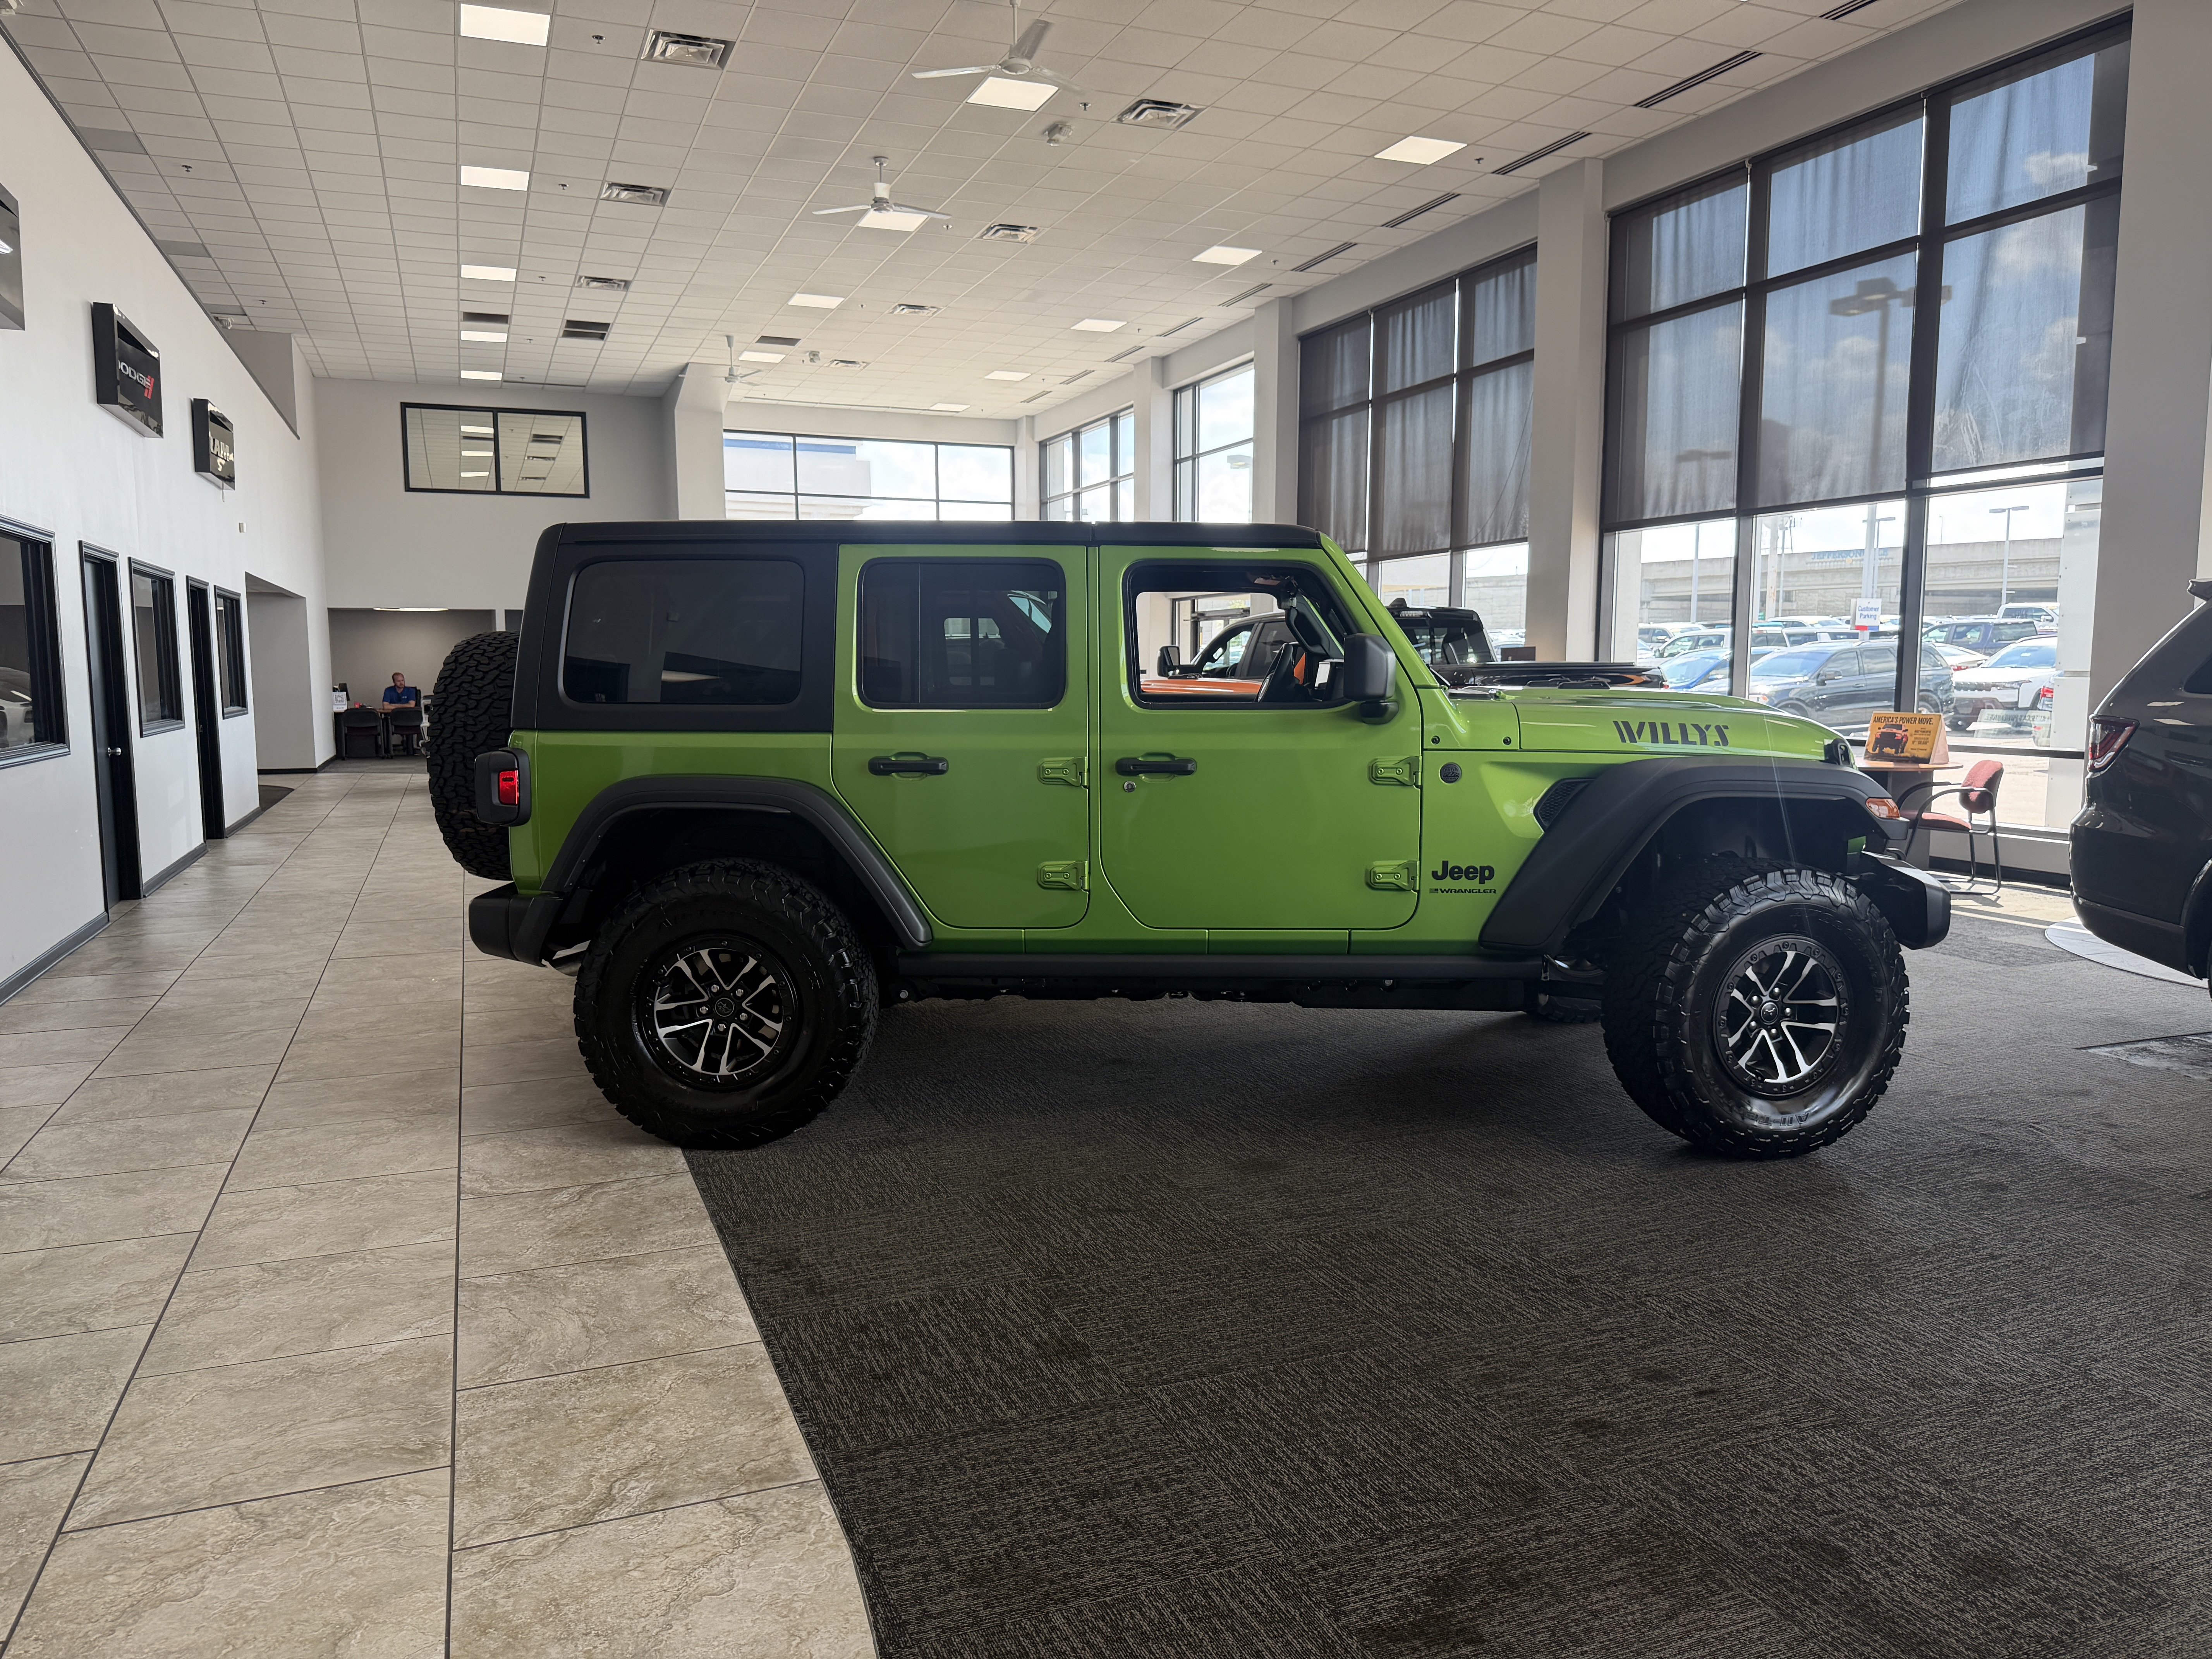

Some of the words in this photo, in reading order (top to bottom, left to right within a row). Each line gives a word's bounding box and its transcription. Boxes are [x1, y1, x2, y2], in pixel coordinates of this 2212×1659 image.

[118, 360, 151, 390] ODGE
[1812, 548, 1888, 560] JEFFERSONLE
[1899, 716, 1917, 725] POWER
[1918, 717, 1934, 725] MOVE.
[1613, 721, 1729, 746] WILLYS
[1431, 860, 1495, 884] Jeep
